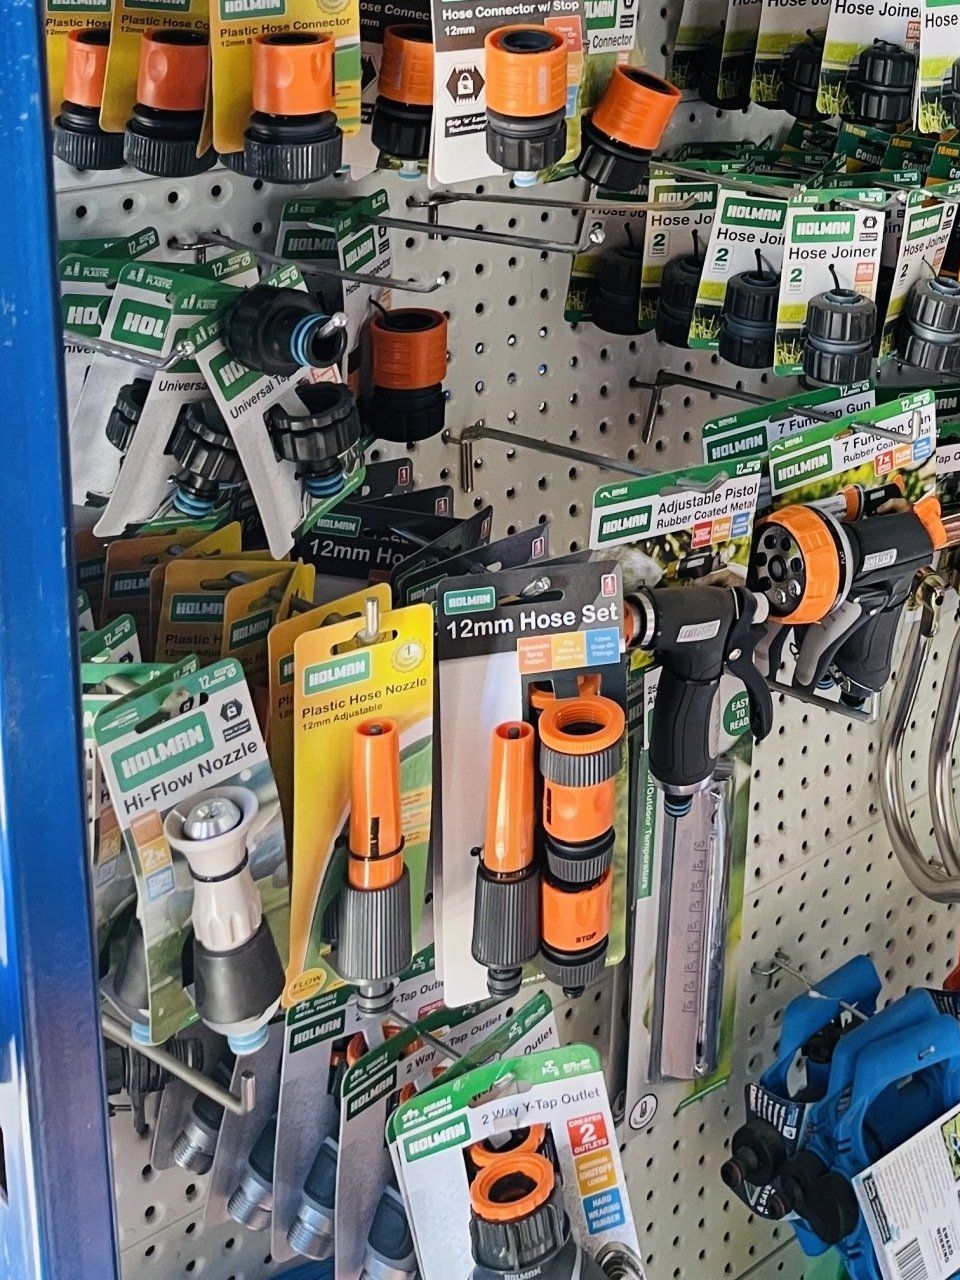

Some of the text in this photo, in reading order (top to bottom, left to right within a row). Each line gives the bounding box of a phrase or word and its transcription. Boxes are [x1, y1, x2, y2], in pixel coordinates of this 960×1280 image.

[442, 0, 580, 21] Hose Connector w/ Stop
[834, 0, 921, 17] Hose Joine
[121, 14, 192, 28] Plastic Hose
[220, 17, 351, 38] Plastic Hose Connector
[924, 12, 958, 28] Hose
[444, 25, 475, 36] 12mm
[593, 34, 633, 49] Connector
[651, 215, 690, 226] Hose
[727, 205, 781, 222] HOLMAN
[796, 222, 850, 236] HOLMAN
[653, 234, 665, 246] 2
[715, 248, 729, 262] 2
[789, 246, 877, 259] Hose Joiner
[211, 260, 240, 277] 12mm
[790, 268, 802, 283] 2
[901, 264, 908, 278] 2
[712, 434, 764, 460] HOLMAN
[778, 453, 829, 481] HOLMAN
[877, 456, 890, 466] 7x
[658, 484, 758, 516] Adjustable Pistol
[656, 499, 755, 530] Rubber Coated Metal
[602, 512, 648, 535] HOLMAN
[448, 595, 492, 608] HOLMAN
[446, 603, 619, 640] 12mm Hose Set
[165, 634, 212, 646] Plastic
[308, 660, 366, 688] HOLMAN
[301, 676, 427, 719] Plastic Hose Nozzle
[302, 704, 383, 732] 12mm Adjustable
[736, 708, 746, 719] TO
[730, 716, 749, 732] READ
[120, 724, 205, 780] HOLMAN
[123, 739, 259, 816] Hi-Flow Nozzle
[294, 1017, 342, 1046] HOLMAN
[523, 1027, 554, 1055] Outlet
[481, 1113, 490, 1126] 2
[522, 1097, 558, 1113] Y-Tap
[560, 1087, 600, 1105] Outlet
[407, 1121, 465, 1155] HOLMAN
[579, 1124, 597, 1141] 2
